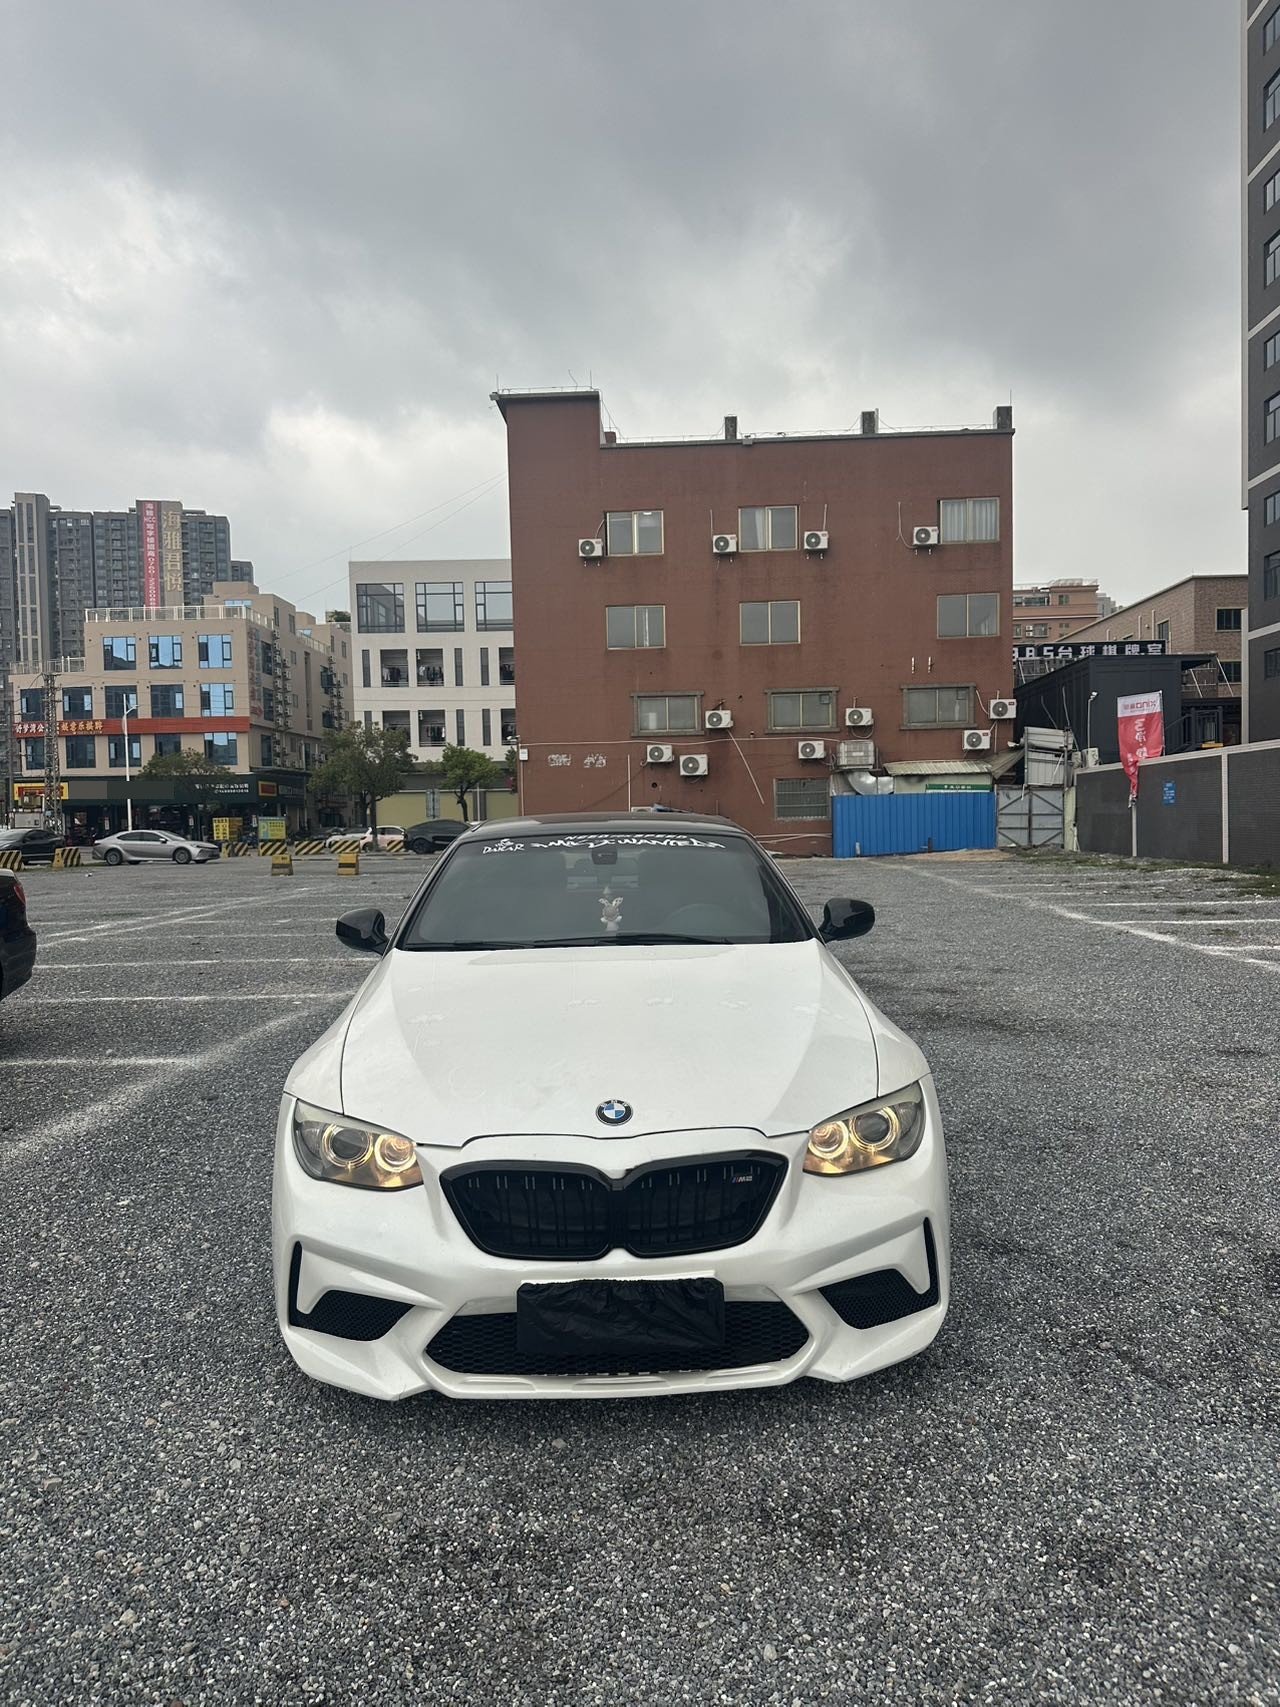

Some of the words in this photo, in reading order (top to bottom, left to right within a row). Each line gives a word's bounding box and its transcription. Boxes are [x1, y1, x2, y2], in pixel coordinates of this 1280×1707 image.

[163, 511, 183, 592] 海雅君悦
[1012, 643, 1163, 661] 985台球棋牌室
[482, 843, 525, 854] DAKAR
